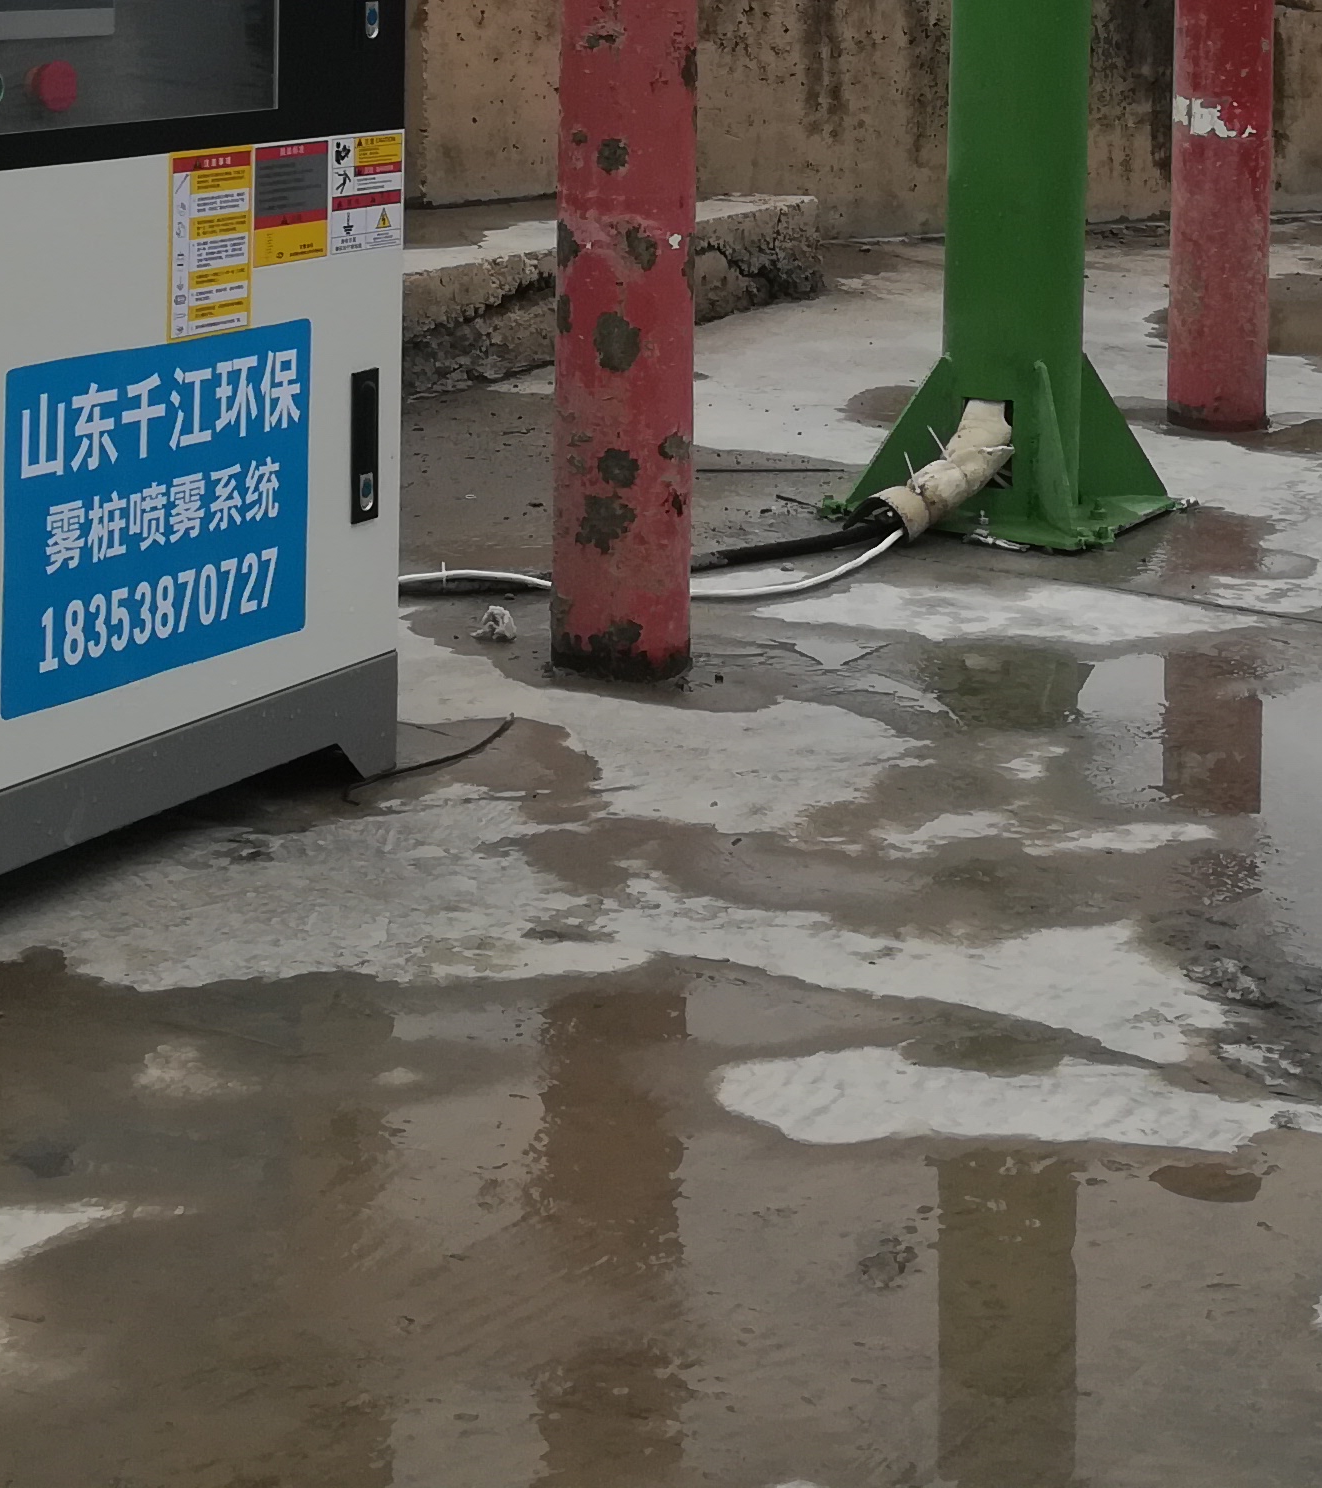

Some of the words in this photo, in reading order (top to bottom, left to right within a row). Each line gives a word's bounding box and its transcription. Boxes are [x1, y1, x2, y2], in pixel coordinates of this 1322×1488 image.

[20, 348, 301, 480] 山东千江环保
[45, 456, 280, 575] 雾桩喷雾系统
[38, 546, 279, 674] 18353870727
